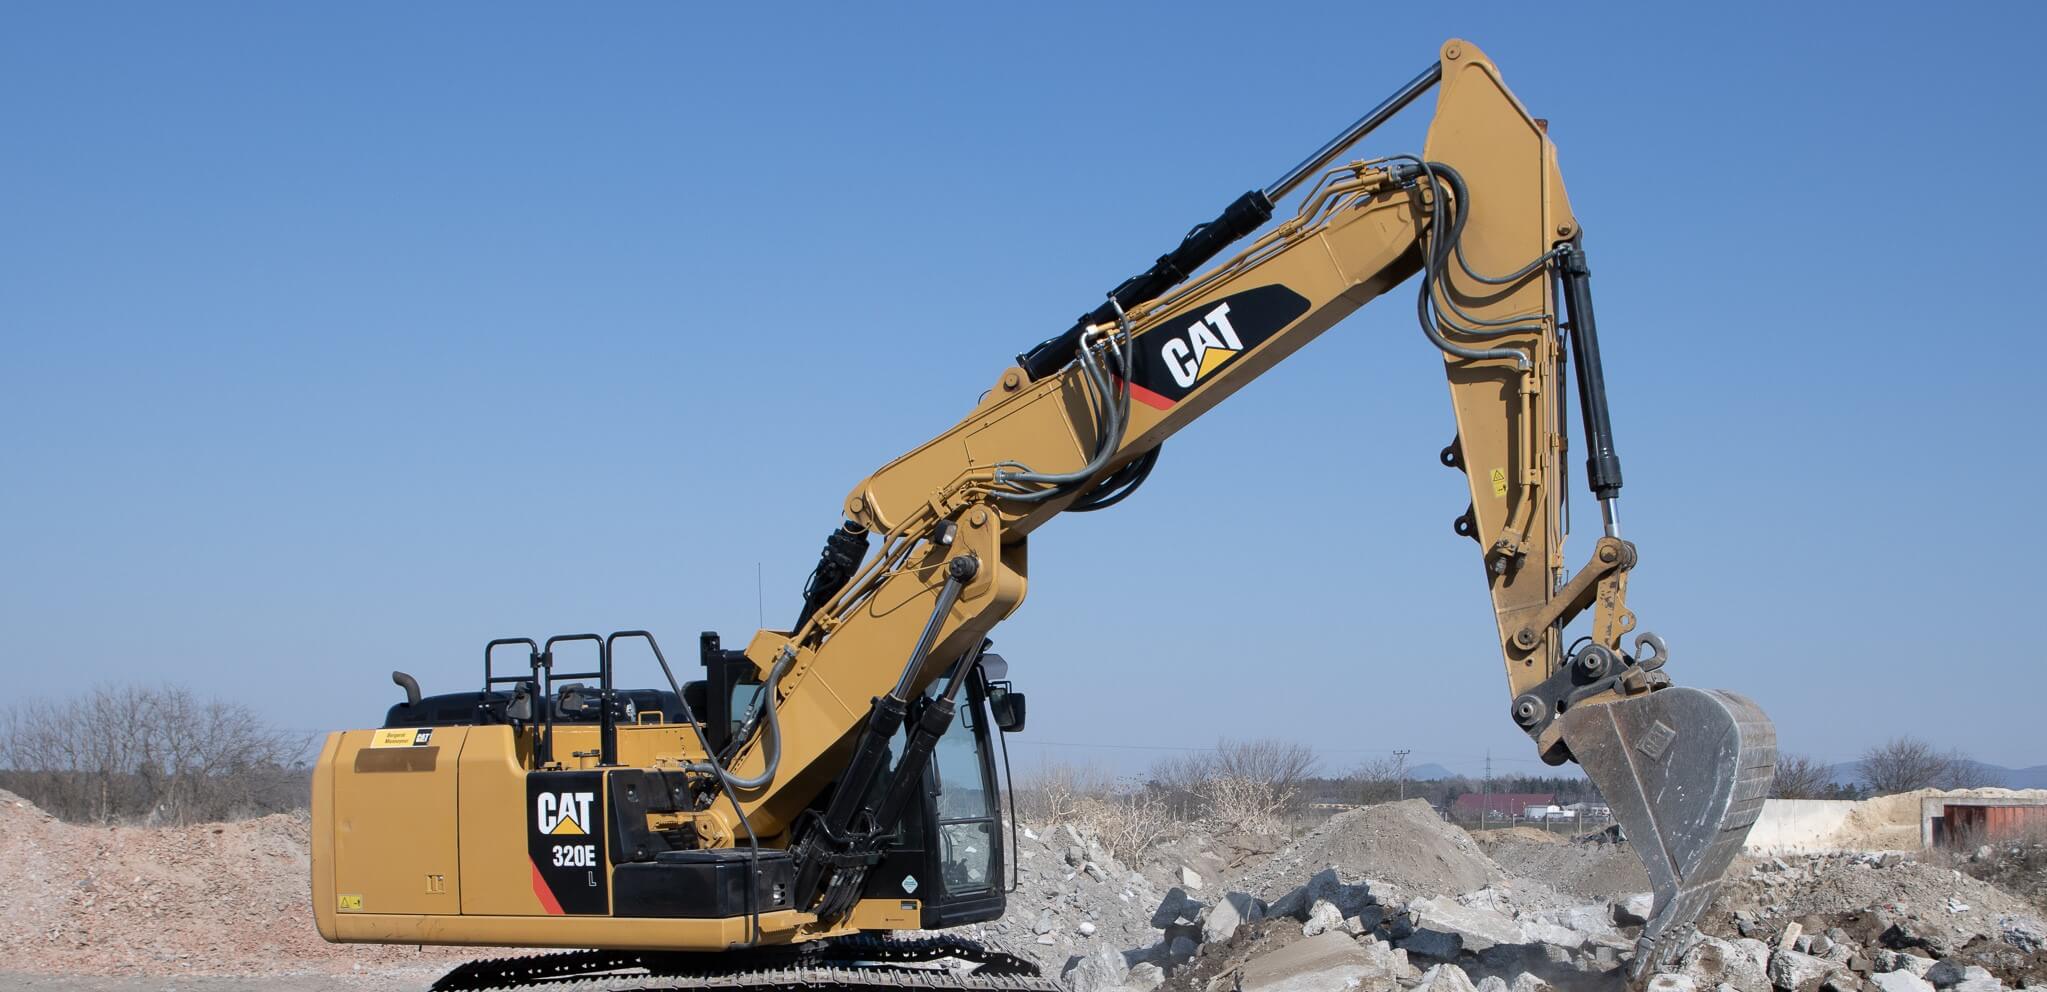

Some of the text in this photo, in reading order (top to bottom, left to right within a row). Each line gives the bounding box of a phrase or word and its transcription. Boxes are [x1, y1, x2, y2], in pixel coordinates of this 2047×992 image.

[1161, 302, 1244, 387] CAT
[537, 792, 594, 835] CAT
[552, 845, 597, 867] 320E
[588, 871, 597, 887] L
